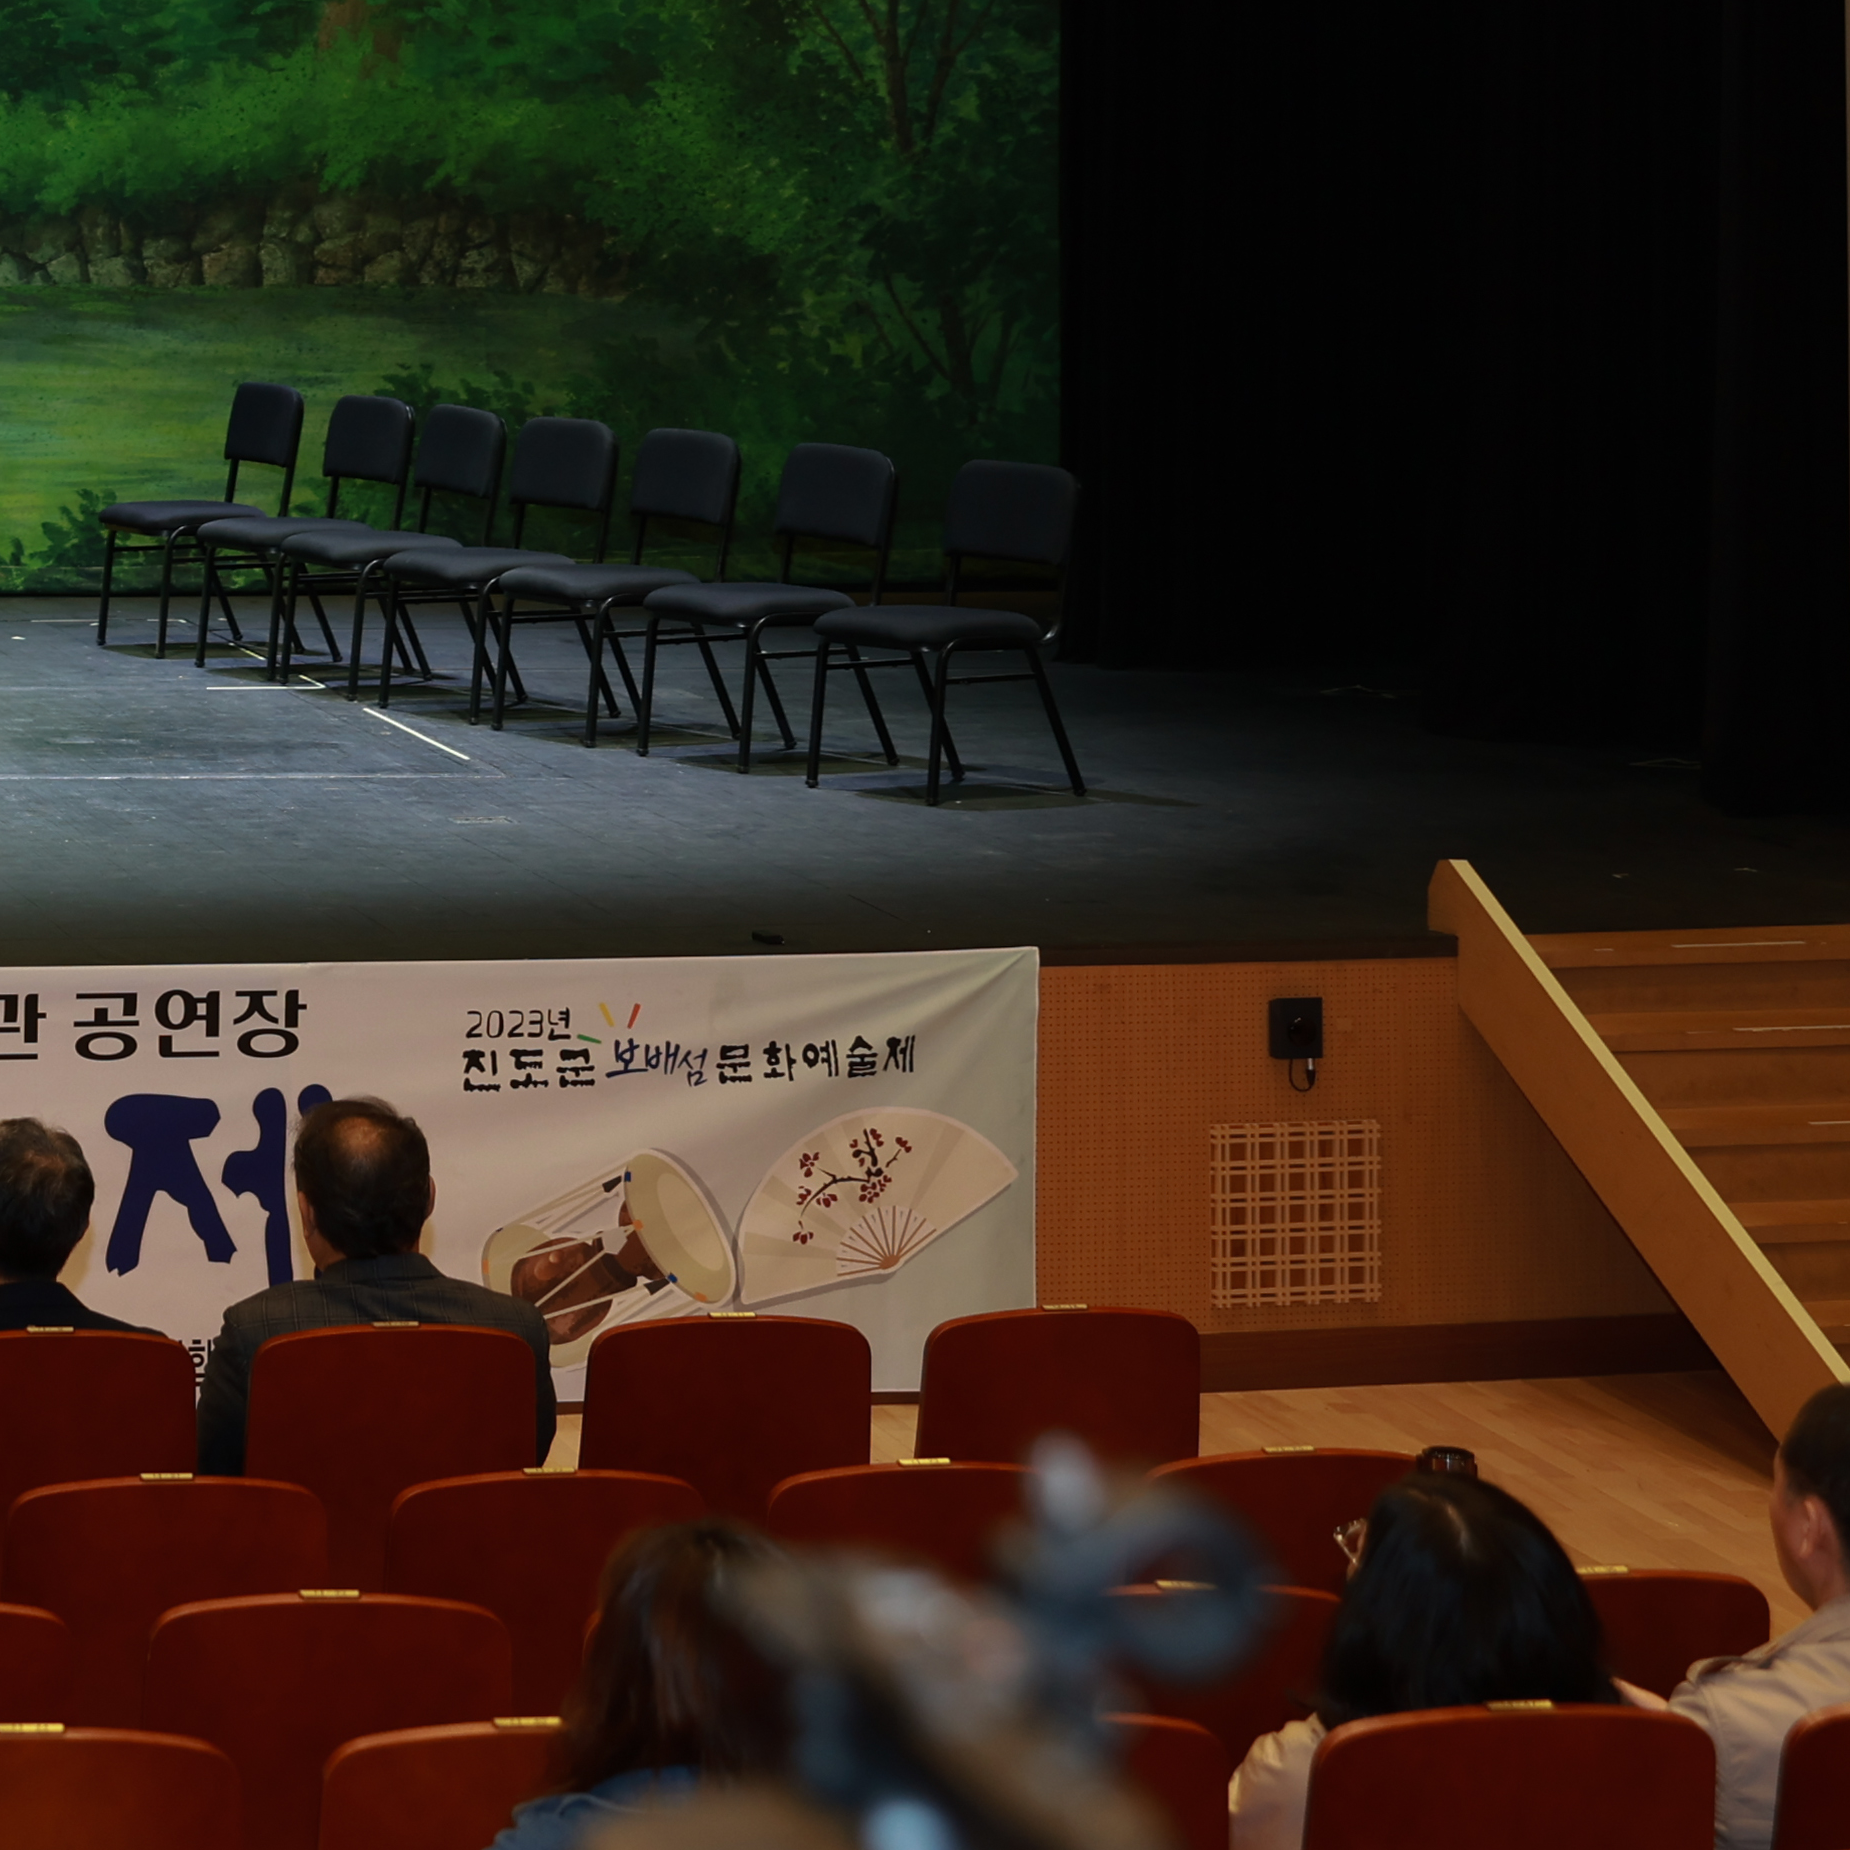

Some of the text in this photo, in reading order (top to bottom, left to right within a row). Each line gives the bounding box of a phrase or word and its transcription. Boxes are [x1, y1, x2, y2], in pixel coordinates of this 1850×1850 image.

[74, 988, 307, 1061] 공연장
[465, 1007, 572, 1041] 2023년
[605, 1038, 709, 1088] 보배섬
[715, 1034, 916, 1084] 문화예술제
